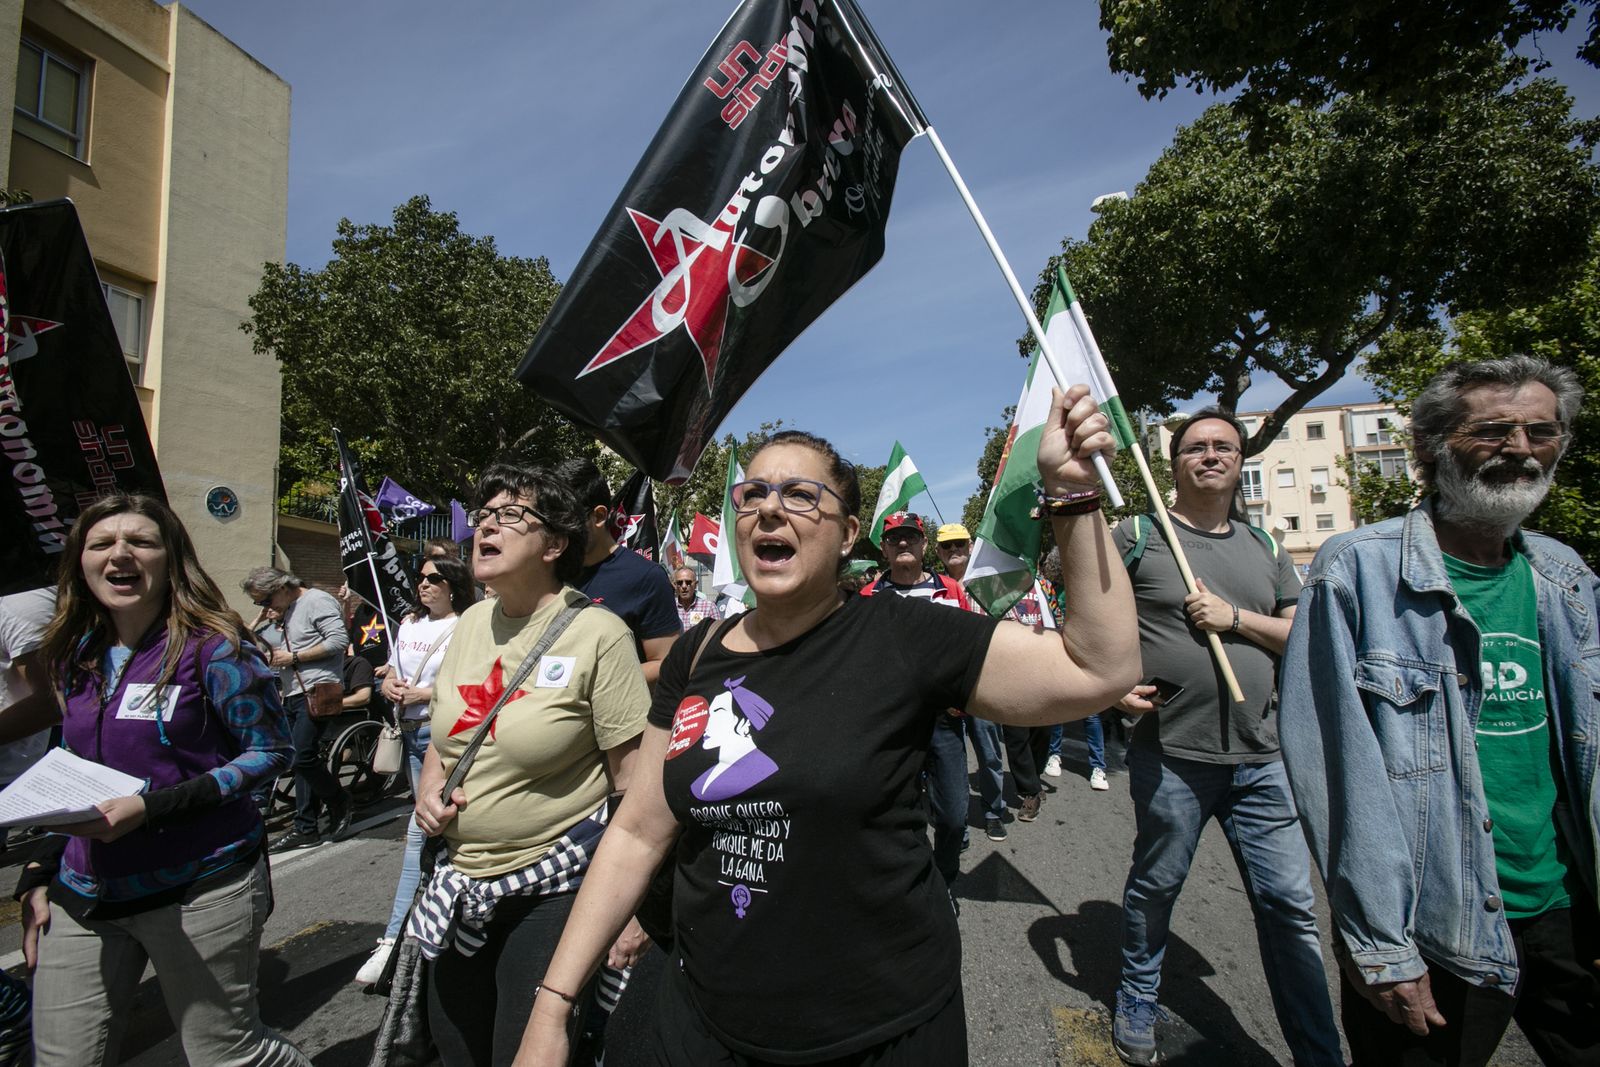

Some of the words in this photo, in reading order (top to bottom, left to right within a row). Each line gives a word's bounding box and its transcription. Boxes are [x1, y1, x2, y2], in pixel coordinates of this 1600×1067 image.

[703, 39, 763, 99] un
[405, 495, 430, 511] CGT
[1482, 687, 1545, 702] ALUCÍA
[782, 819, 791, 840] Y
[712, 830, 748, 857] PORQUE
[750, 837, 765, 860] ME
[767, 842, 785, 863] DA
[721, 854, 734, 877] LA
[735, 858, 767, 884] GANA.
